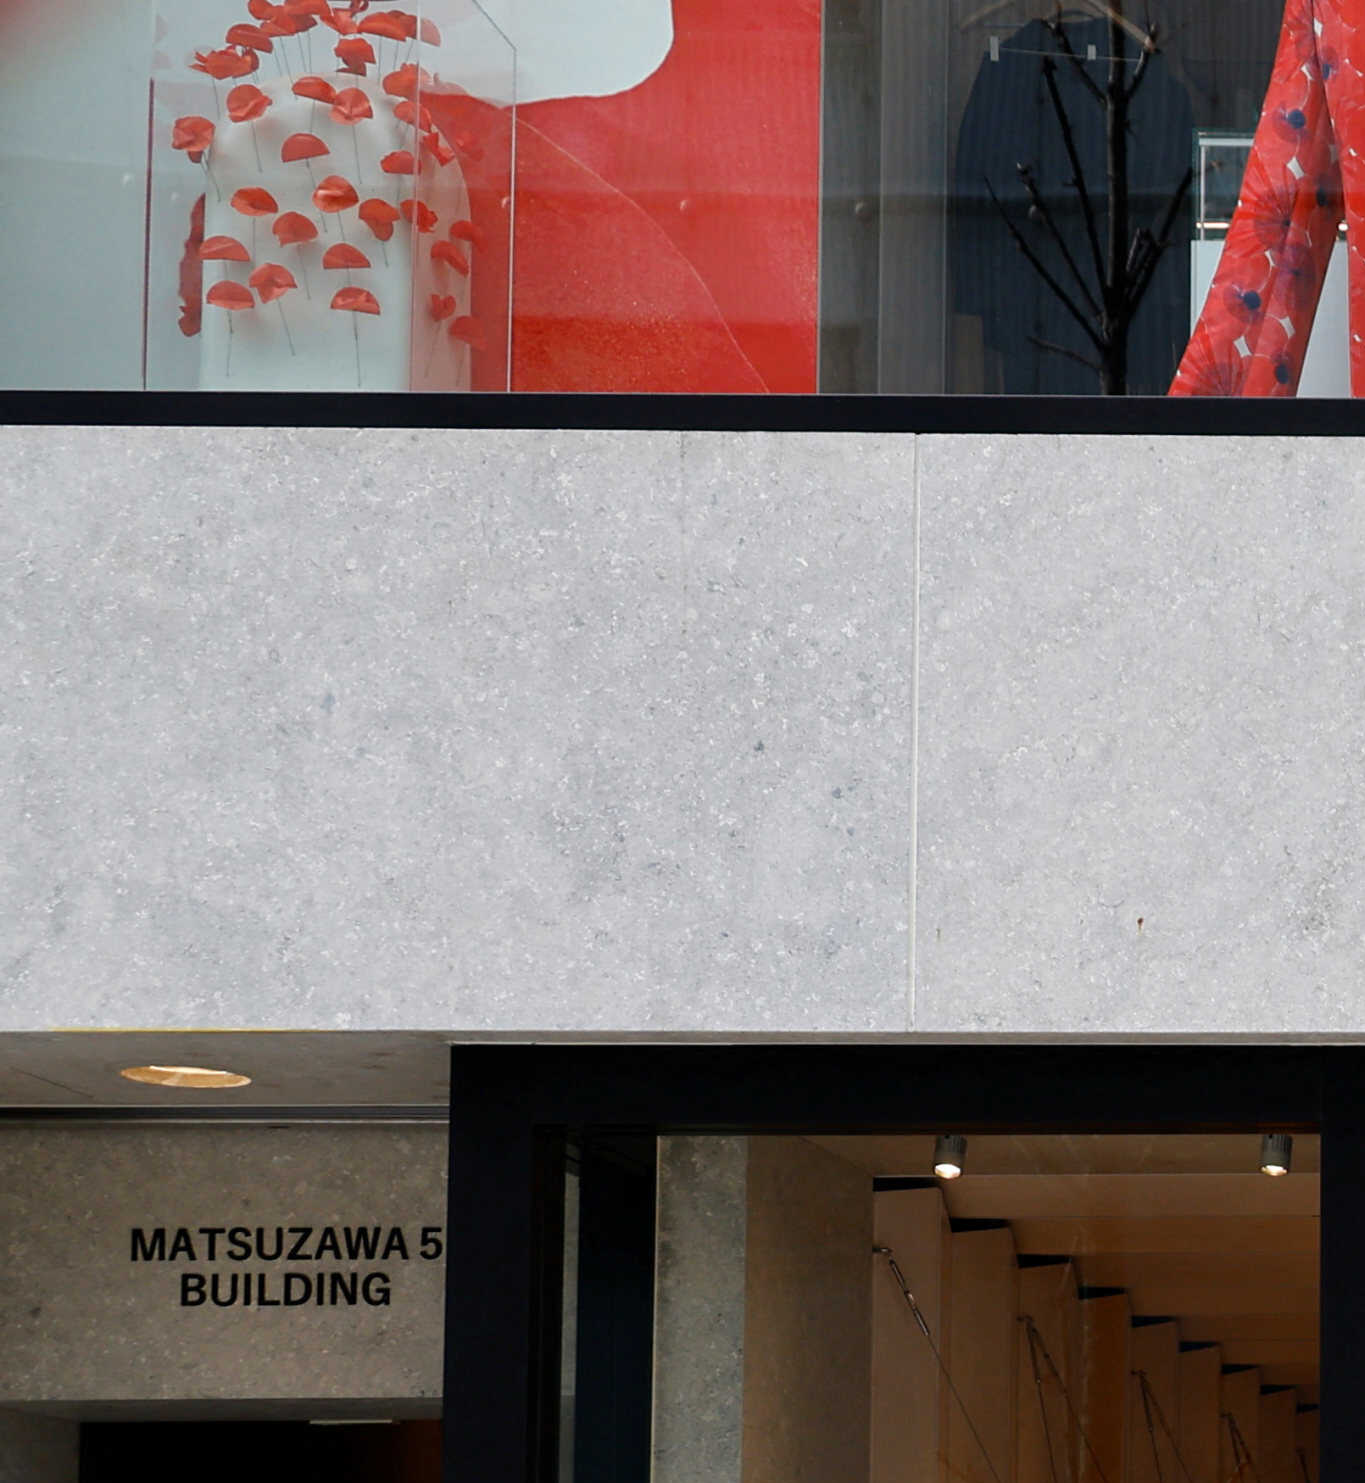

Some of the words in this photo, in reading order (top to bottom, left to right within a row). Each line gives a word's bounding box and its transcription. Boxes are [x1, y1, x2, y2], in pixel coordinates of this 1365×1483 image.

[130, 1226, 409, 1262] MATSUZAWA
[419, 1226, 443, 1261] 5
[180, 1271, 391, 1307] BUILDING
